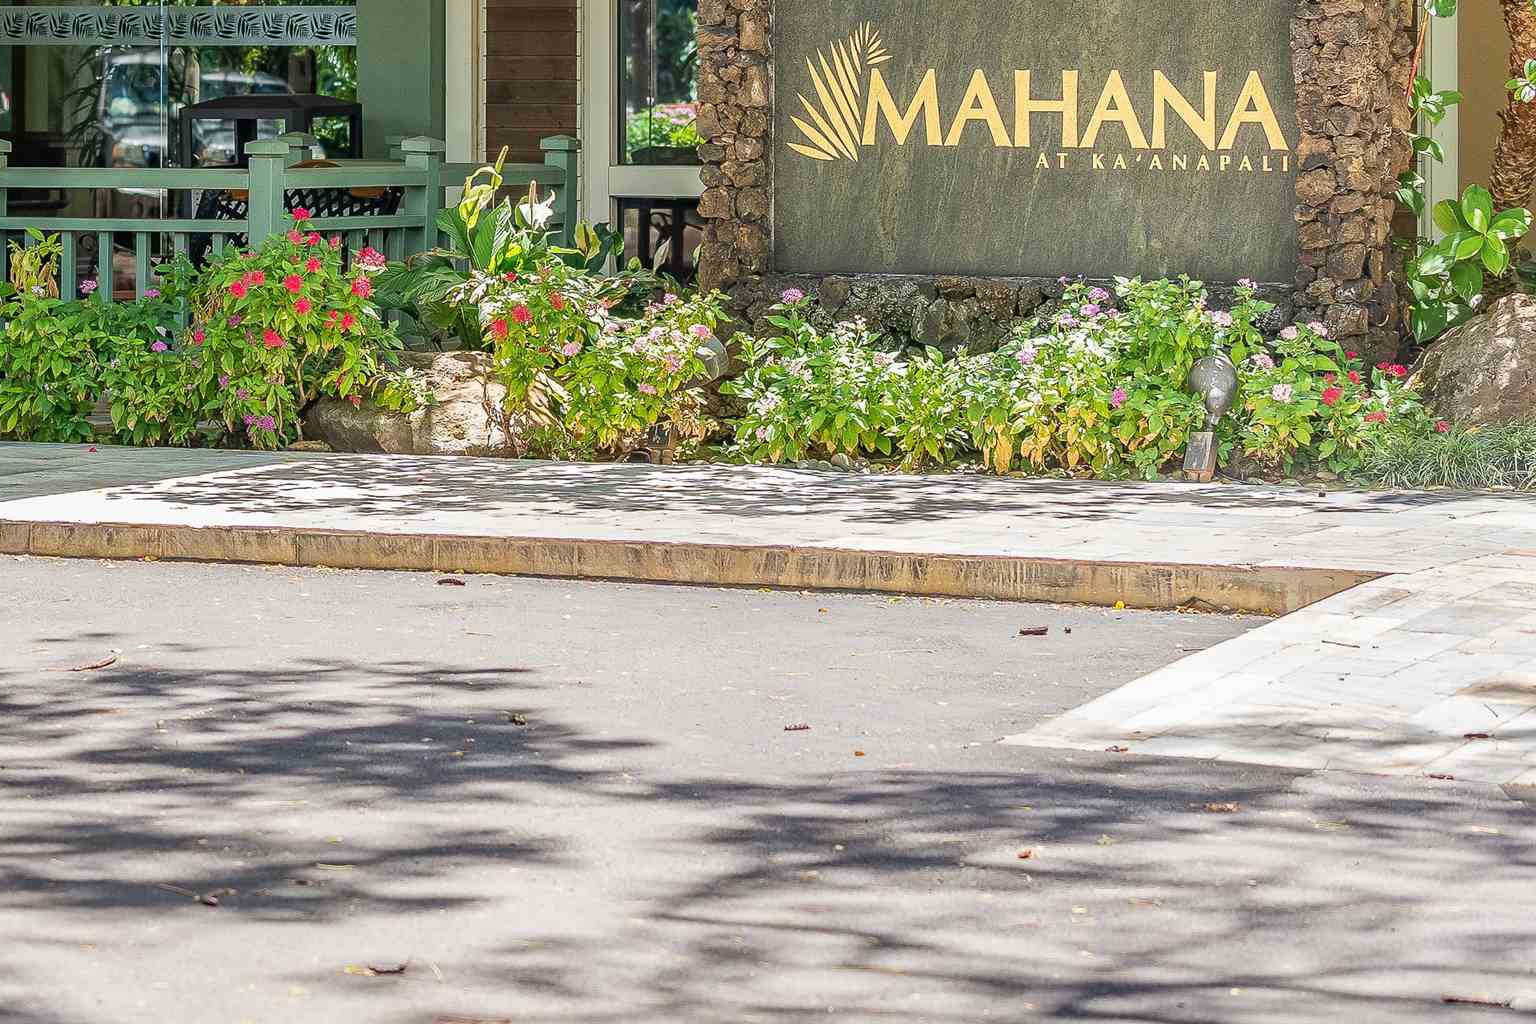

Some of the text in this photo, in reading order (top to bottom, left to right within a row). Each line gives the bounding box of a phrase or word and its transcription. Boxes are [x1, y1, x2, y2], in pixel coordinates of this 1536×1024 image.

[861, 68, 1290, 151] MAHANA
[1035, 152, 1289, 172] AT KA'ANAPALI
